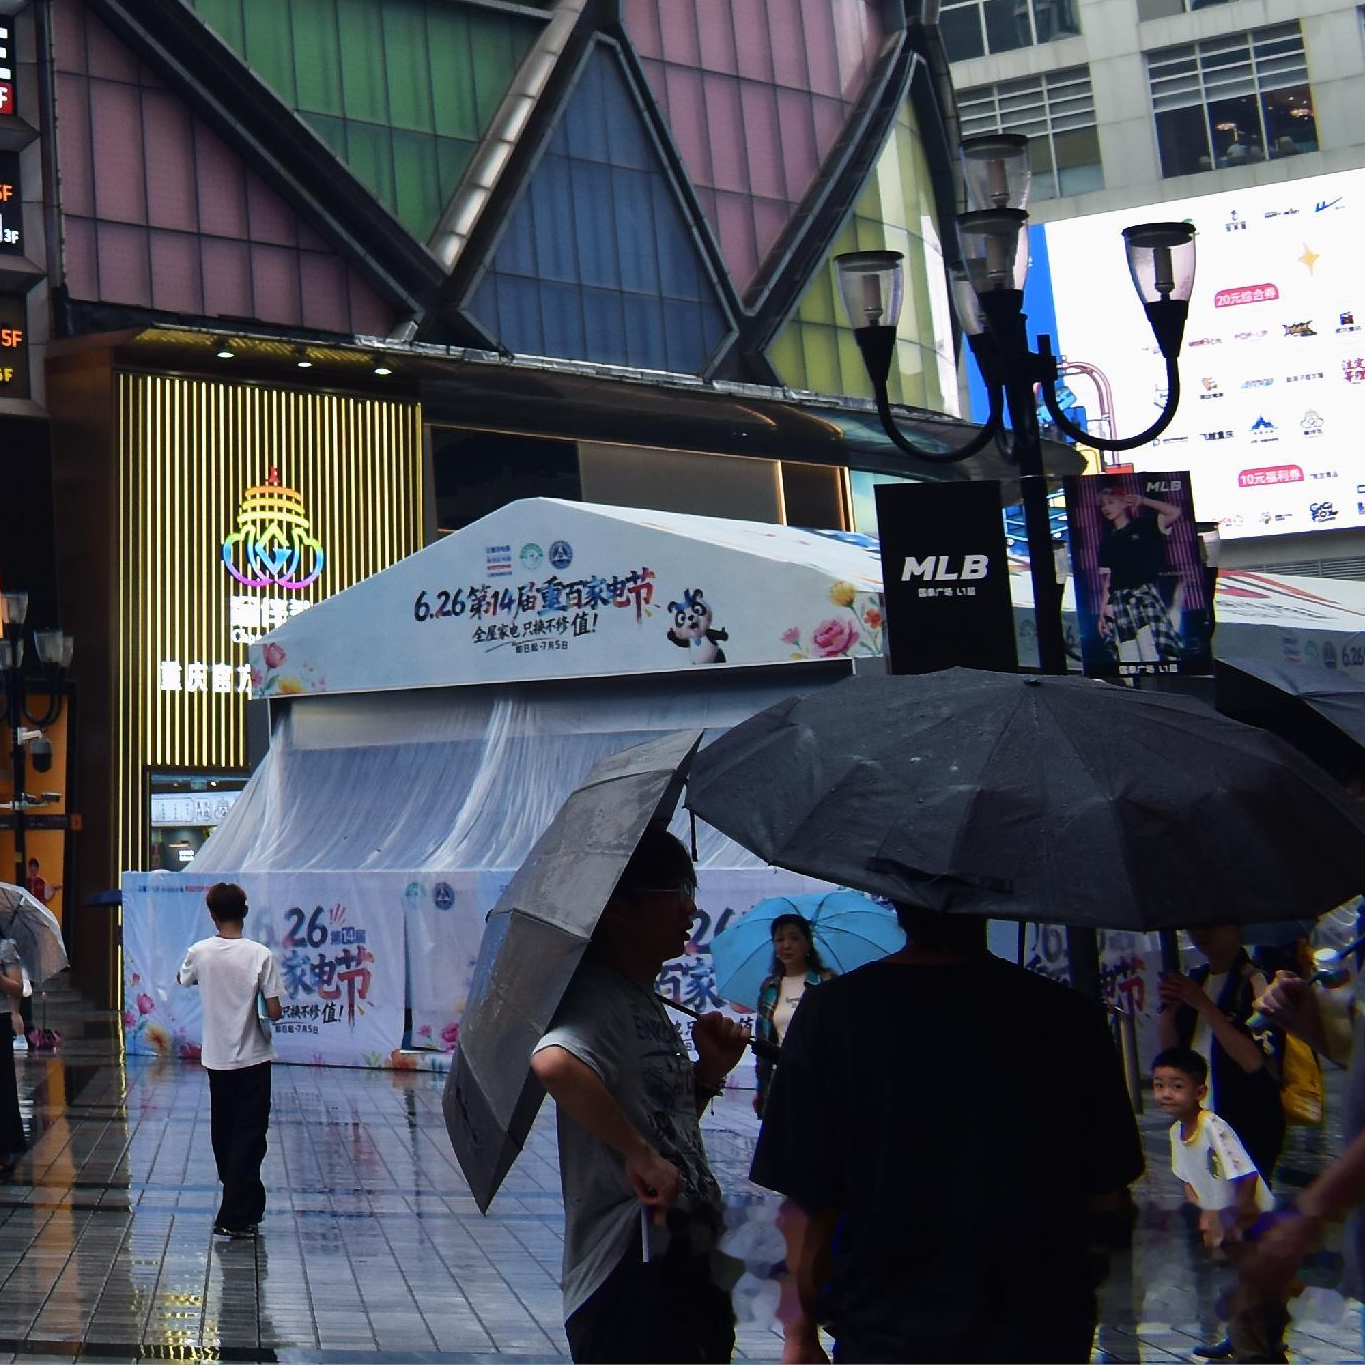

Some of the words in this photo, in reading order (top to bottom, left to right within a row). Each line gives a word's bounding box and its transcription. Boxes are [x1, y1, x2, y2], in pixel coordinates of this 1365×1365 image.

[3, 228, 20, 245] 3F
[2, 329, 23, 347] 5F
[1146, 480, 1182, 493] MLB
[901, 554, 989, 581] MLB
